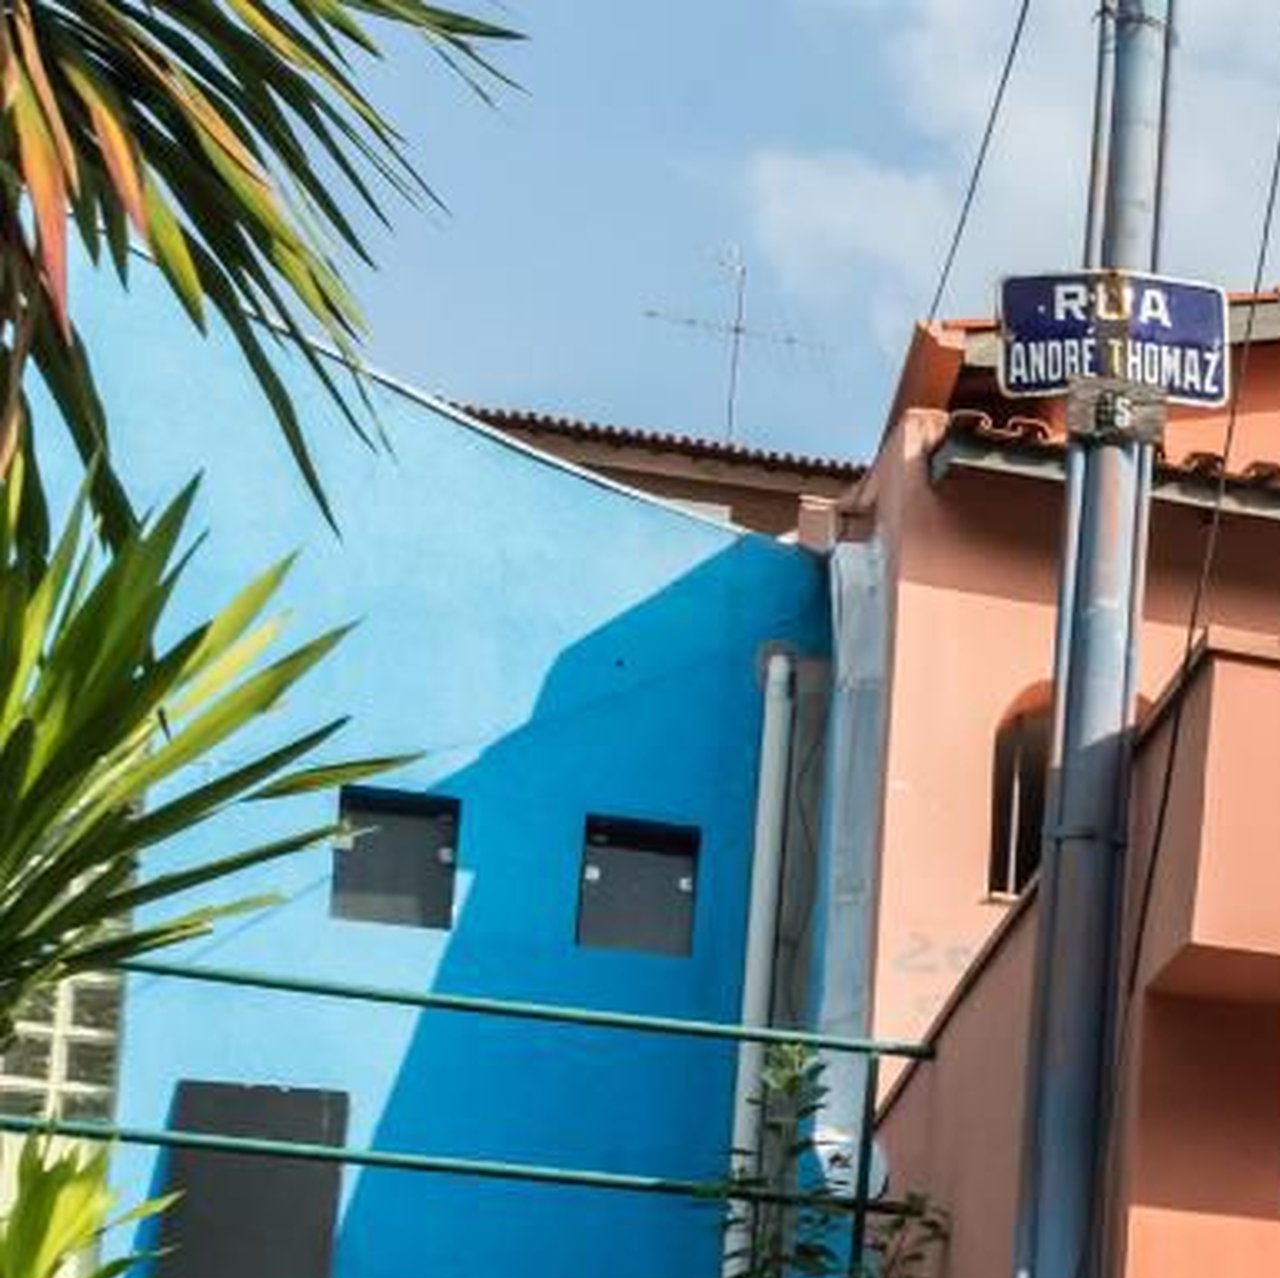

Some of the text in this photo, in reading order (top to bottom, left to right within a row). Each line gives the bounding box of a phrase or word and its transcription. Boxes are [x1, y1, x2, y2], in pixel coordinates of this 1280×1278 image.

[1054, 283, 1172, 328] RUA
[1009, 326, 1221, 394] ANDRÉ THOMAZ
